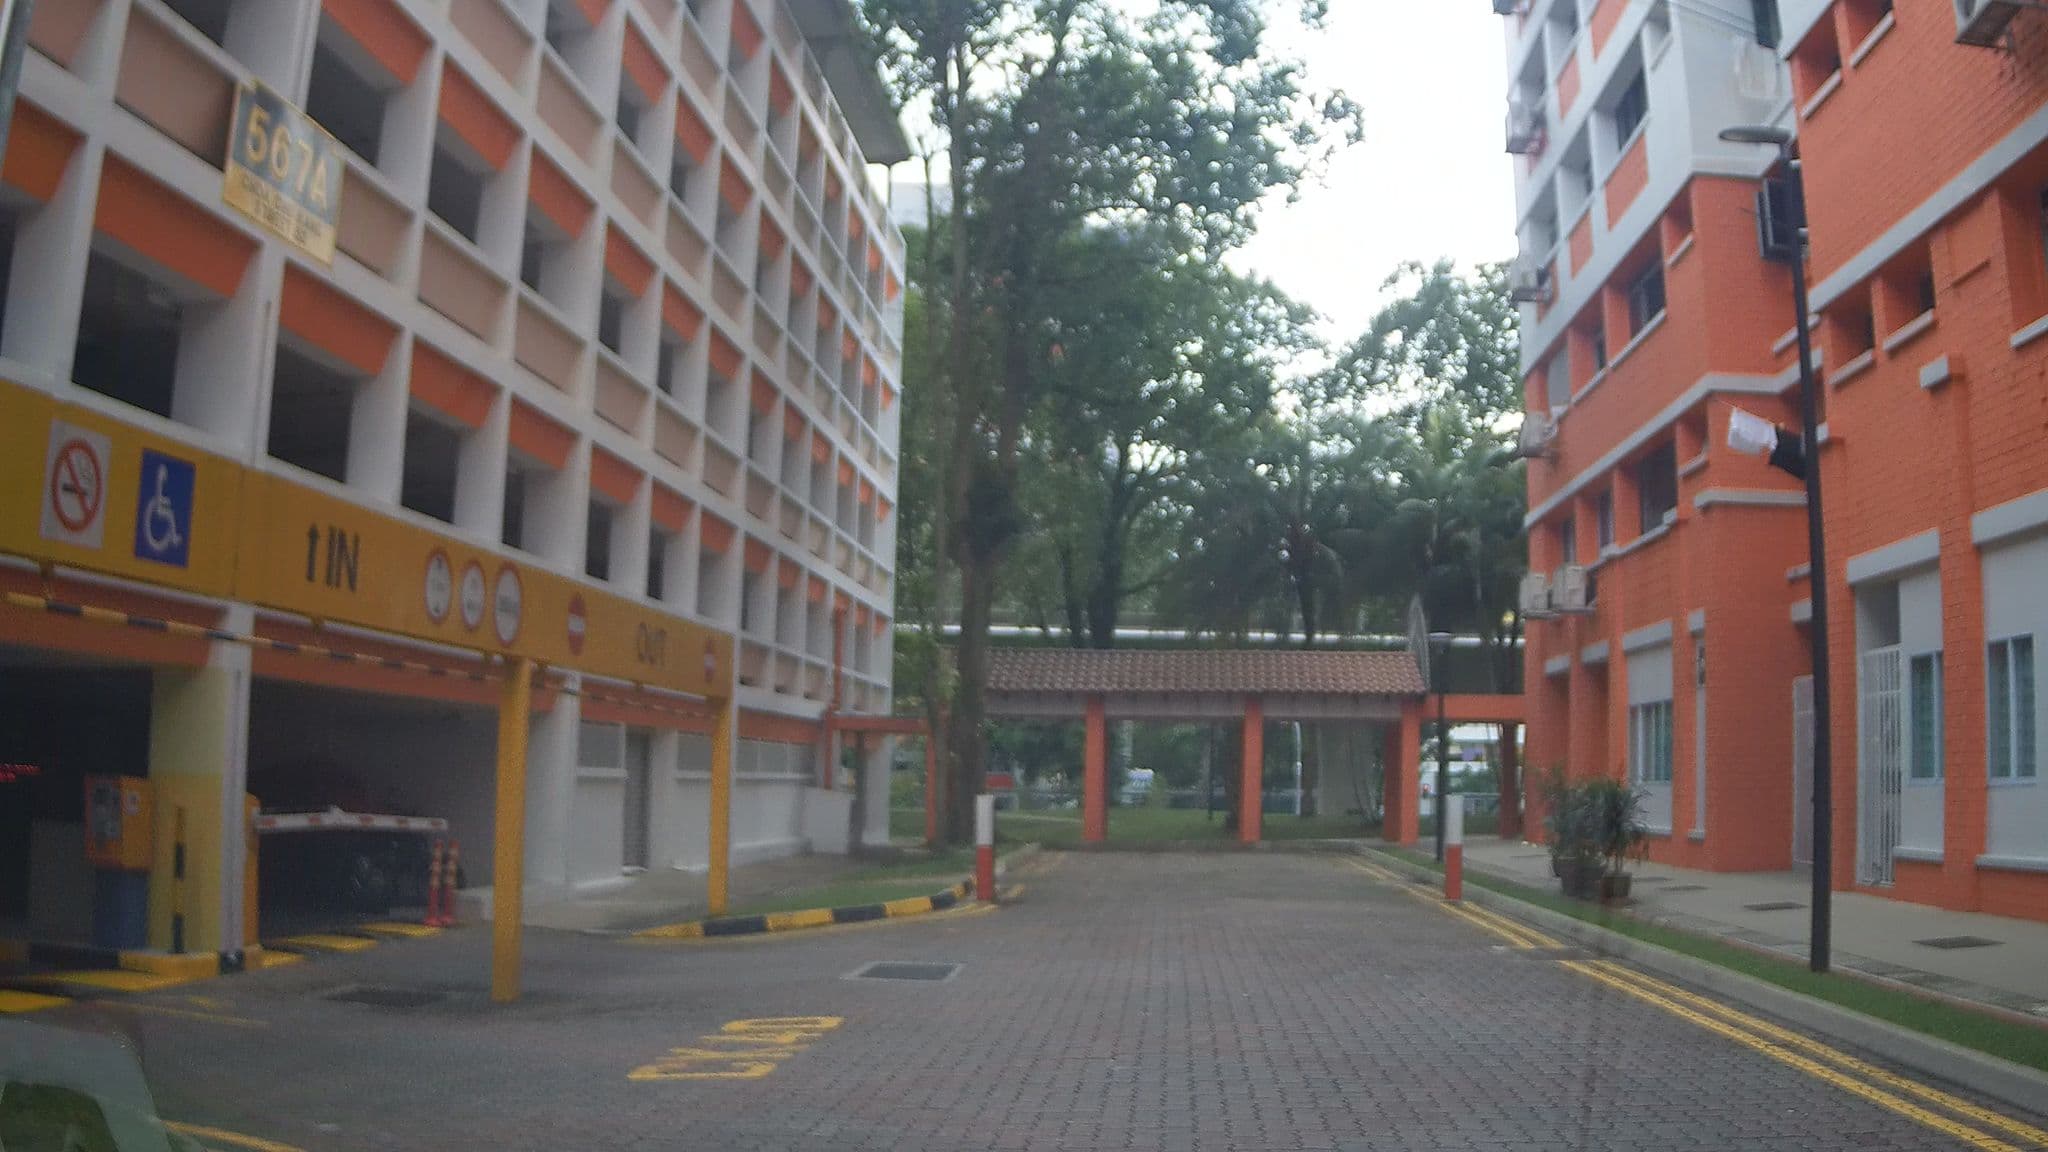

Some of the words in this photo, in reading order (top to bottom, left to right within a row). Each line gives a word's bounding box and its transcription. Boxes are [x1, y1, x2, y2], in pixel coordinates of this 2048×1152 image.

[245, 104, 329, 211] 567A
[326, 523, 361, 593] IN
[636, 621, 668, 672] OUT
